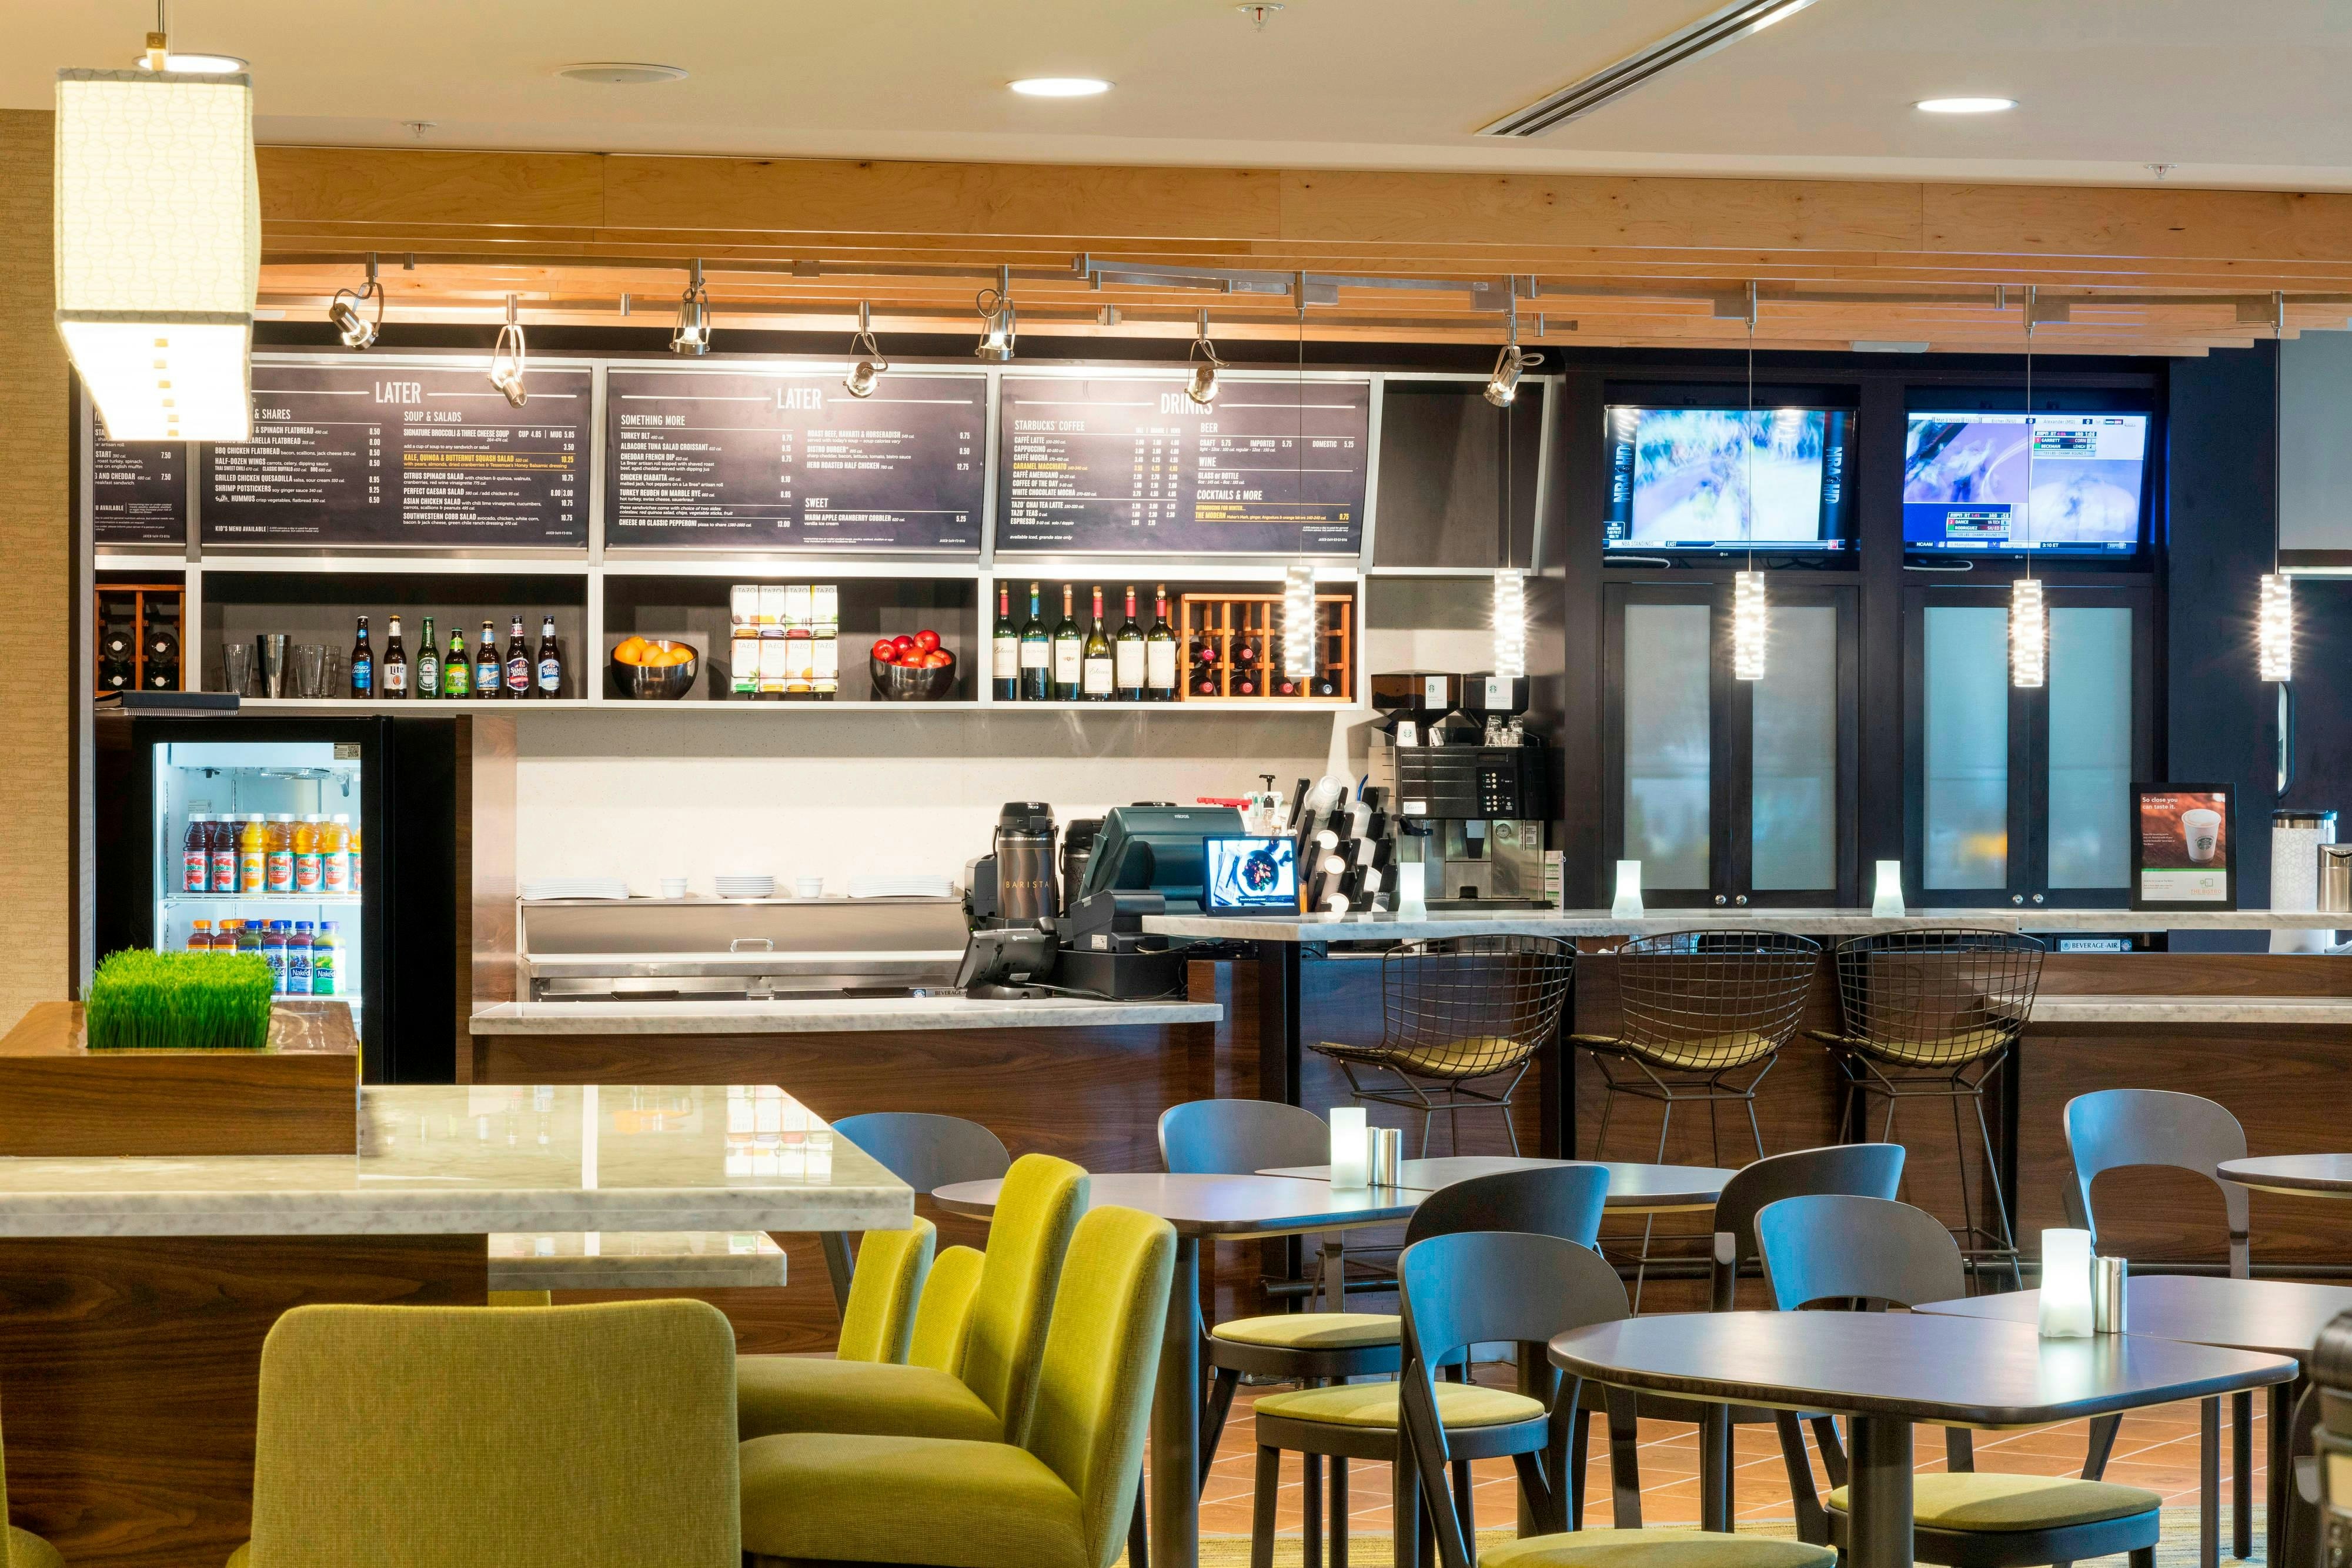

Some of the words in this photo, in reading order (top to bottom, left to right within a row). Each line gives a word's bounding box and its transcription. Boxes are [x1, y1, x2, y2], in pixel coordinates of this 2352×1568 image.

[376, 381, 421, 404] LATER
[777, 387, 821, 410] LATER
[1160, 393, 1212, 414] DRINKS
[255, 409, 260, 419] &
[262, 409, 291, 420] SHARES
[404, 411, 423, 422] SOUP
[426, 412, 431, 422] &
[434, 412, 462, 422] SALADS
[621, 414, 663, 426] SOMETHING
[665, 415, 685, 426] MORE
[432, 429, 456, 437] BROCCOLI
[496, 430, 509, 438] SOUP
[1200, 423, 1218, 433] BEER
[420, 454, 440, 462] QUINOA
[1616, 445, 1632, 465] HD
[1199, 457, 1217, 467] WINE
[1826, 447, 1843, 475] NBA
[1613, 473, 1631, 503] NBA
[1197, 490, 1234, 500] COCKTAILS
[1235, 490, 1241, 500] &
[1243, 490, 1262, 500] MORE
[1823, 484, 1840, 504] HD
[805, 497, 828, 508] SWEET
[390, 665, 404, 675] Lite
